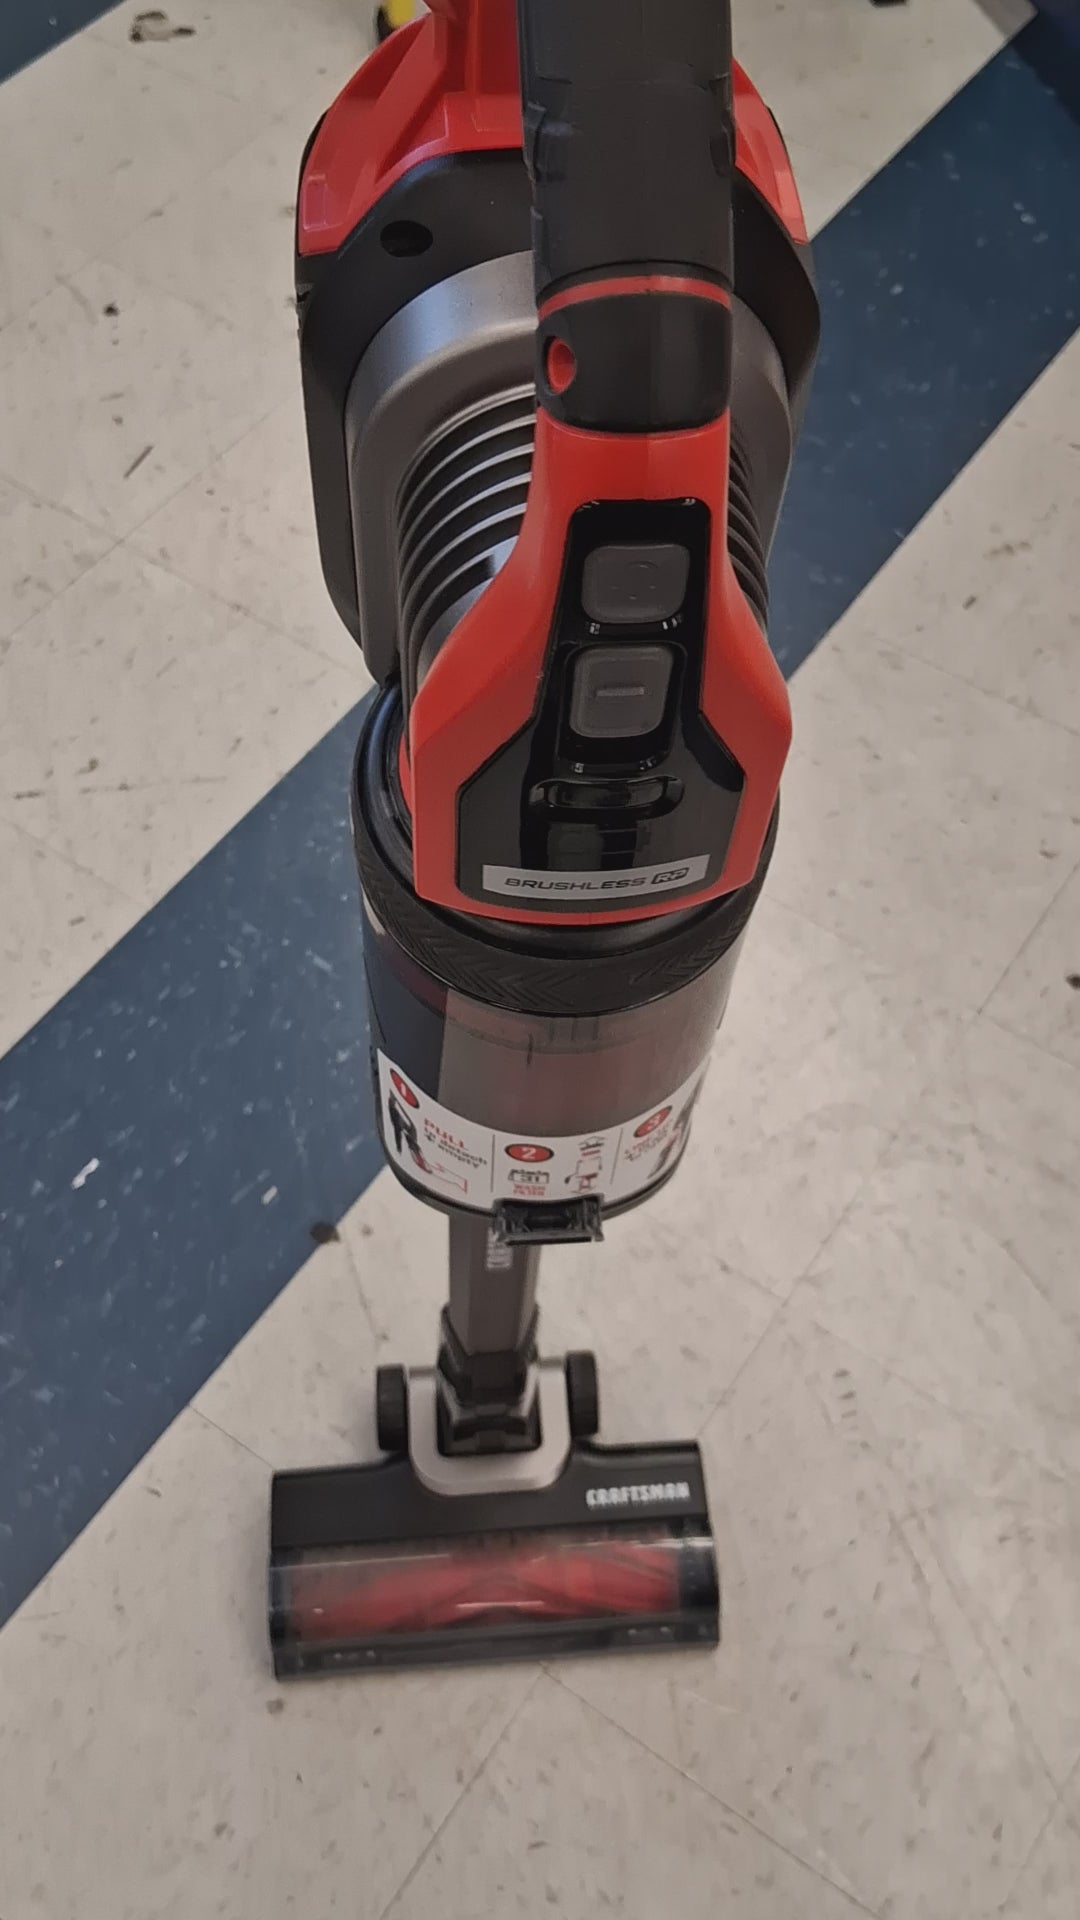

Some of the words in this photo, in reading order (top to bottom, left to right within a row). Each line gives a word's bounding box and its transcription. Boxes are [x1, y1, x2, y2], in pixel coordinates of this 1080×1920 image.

[505, 877, 648, 890] BRUSHLESS
[654, 868, 689, 884] RP
[522, 1147, 537, 1160] 2
